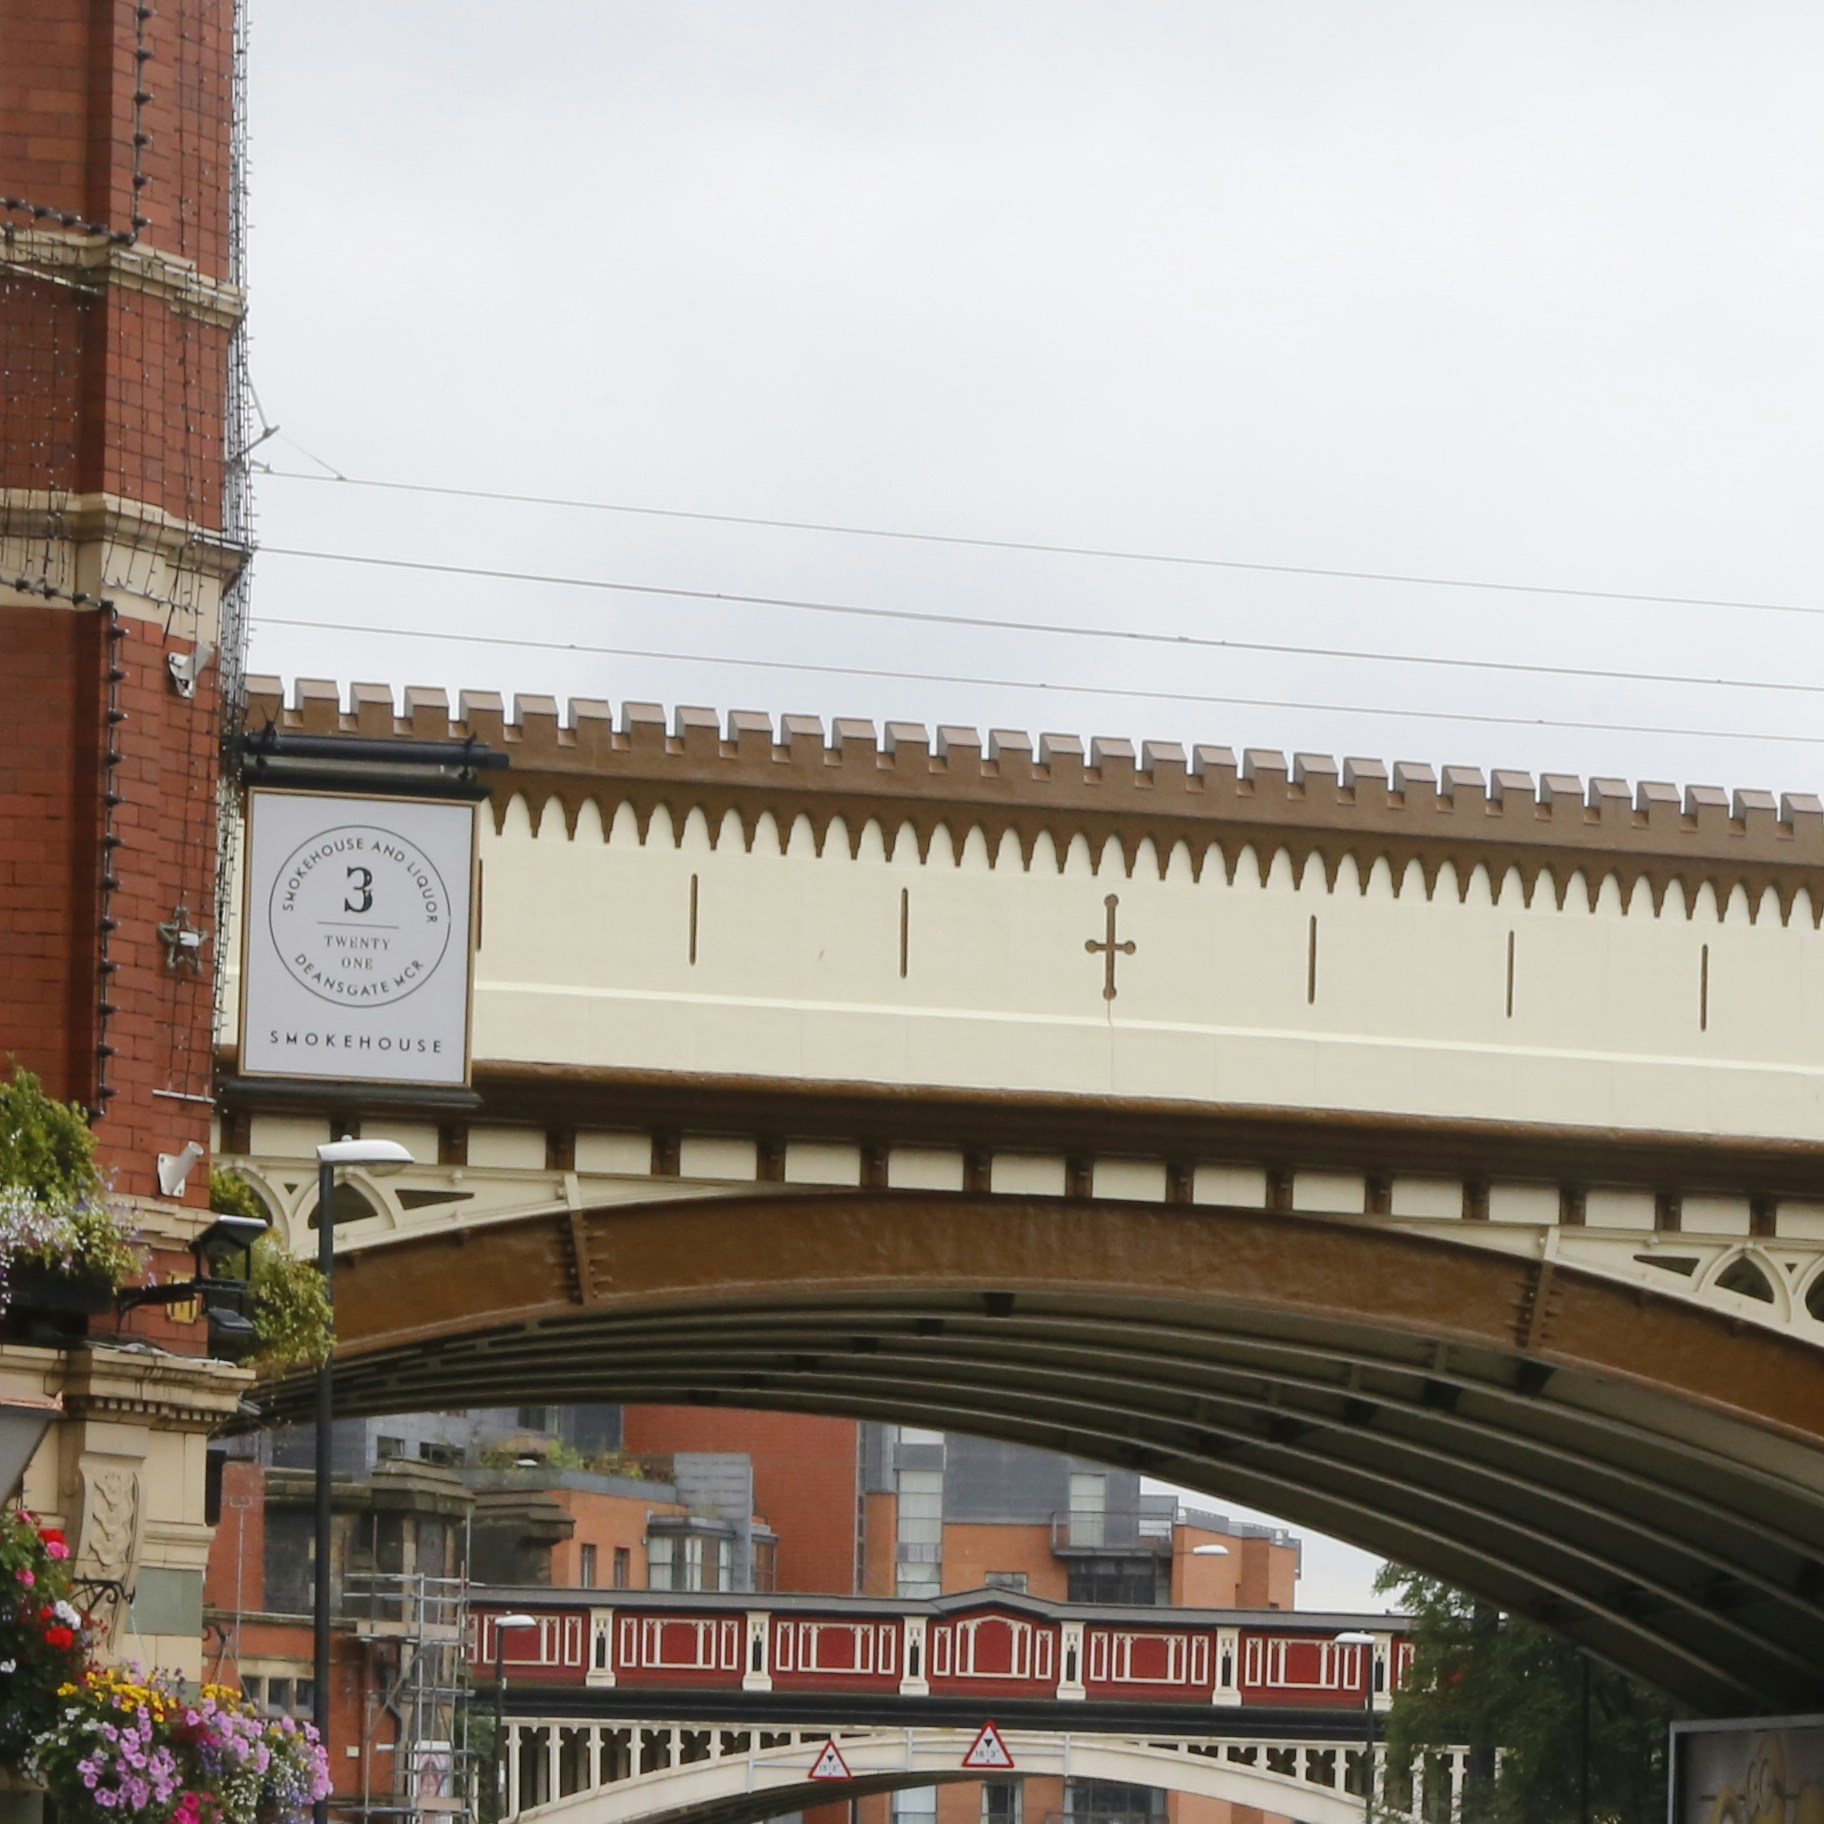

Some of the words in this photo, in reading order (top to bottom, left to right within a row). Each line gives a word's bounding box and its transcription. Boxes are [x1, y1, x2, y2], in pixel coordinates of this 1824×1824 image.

[282, 837, 365, 911] SMOKEHOUSE
[371, 840, 406, 864] AND
[407, 862, 439, 925] LIQUOR
[343, 866, 374, 914] 3
[324, 935, 391, 951] TWENTY
[294, 953, 391, 998] DEANSGATE
[394, 958, 425, 989] MCR
[341, 957, 373, 971] ONE
[269, 1030, 443, 1054] SMOKEHOUSE
